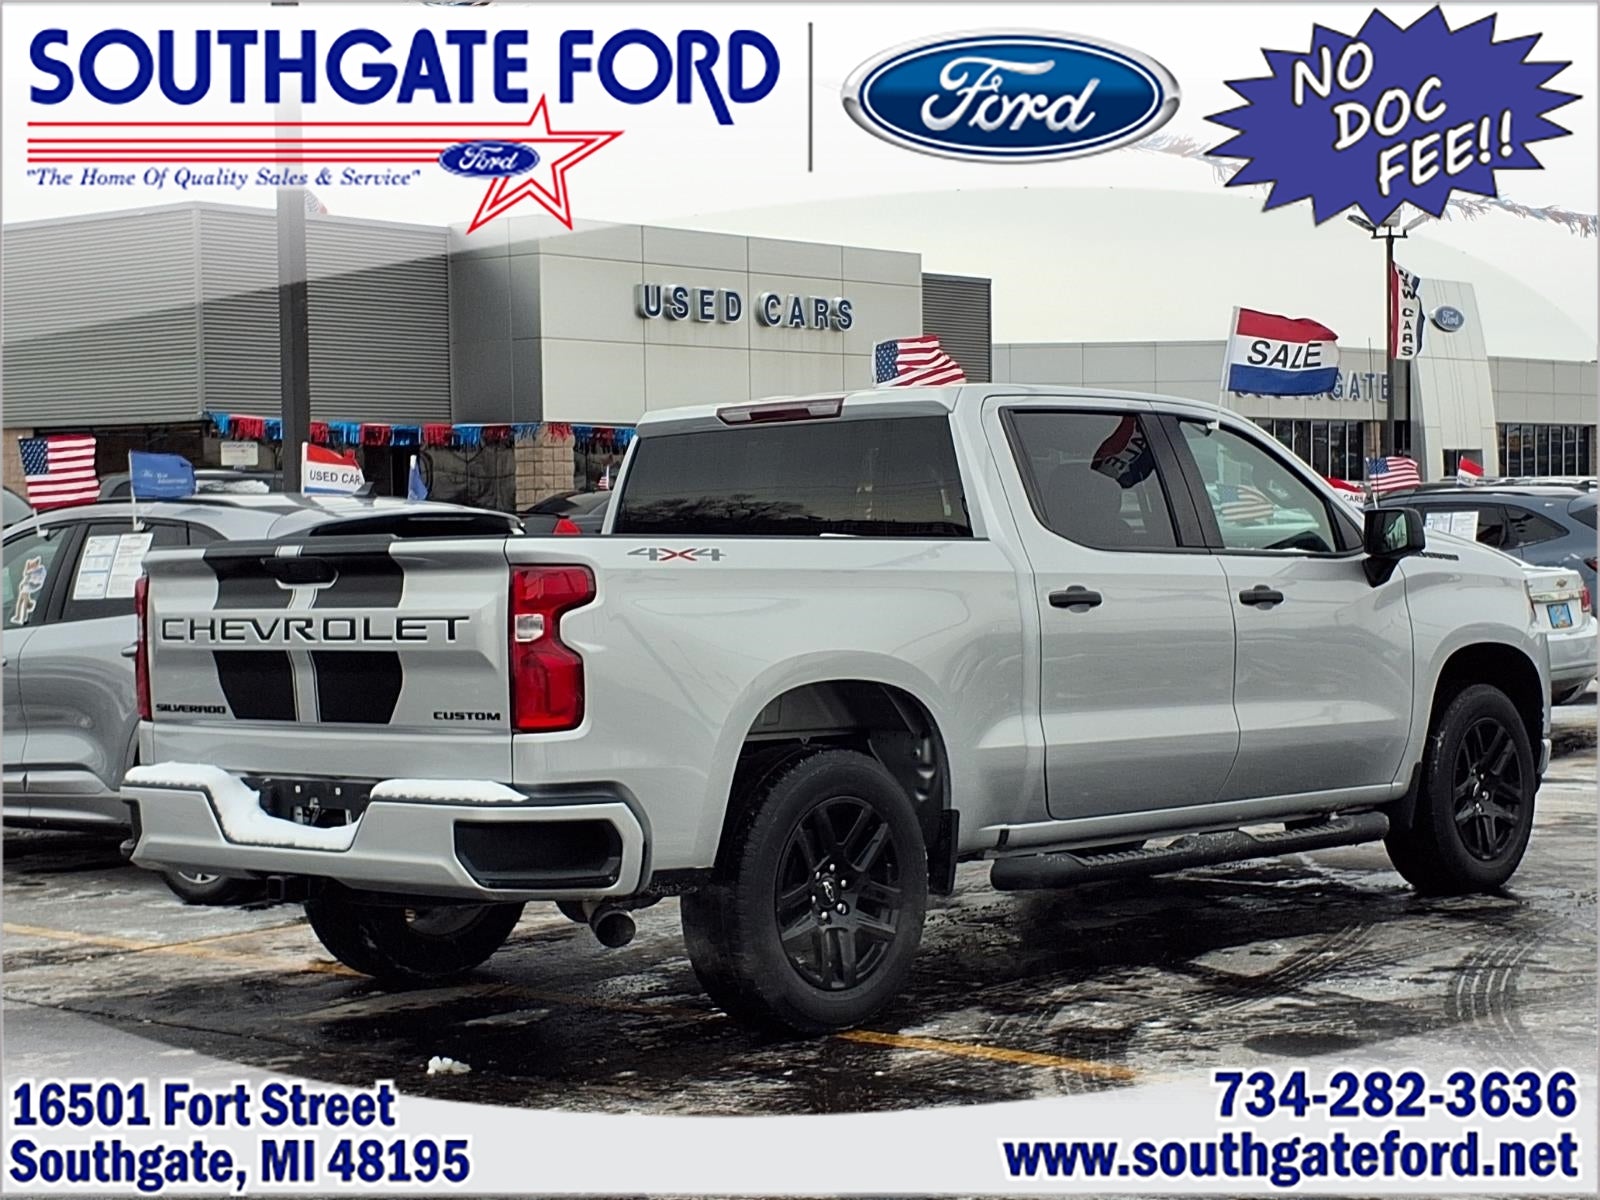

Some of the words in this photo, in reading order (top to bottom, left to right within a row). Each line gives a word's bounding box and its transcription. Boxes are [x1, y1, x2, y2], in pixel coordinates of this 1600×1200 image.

[637, 283, 742, 323] USED
[757, 292, 854, 332] CARS
[1401, 307, 1414, 356] CARS
[1247, 340, 1323, 369] SALE
[309, 469, 339, 483] USED
[341, 472, 363, 485] CAR
[161, 615, 471, 643] CHEVROLET
[156, 703, 226, 714] SILVERADO
[433, 711, 501, 721] CUSTOM
